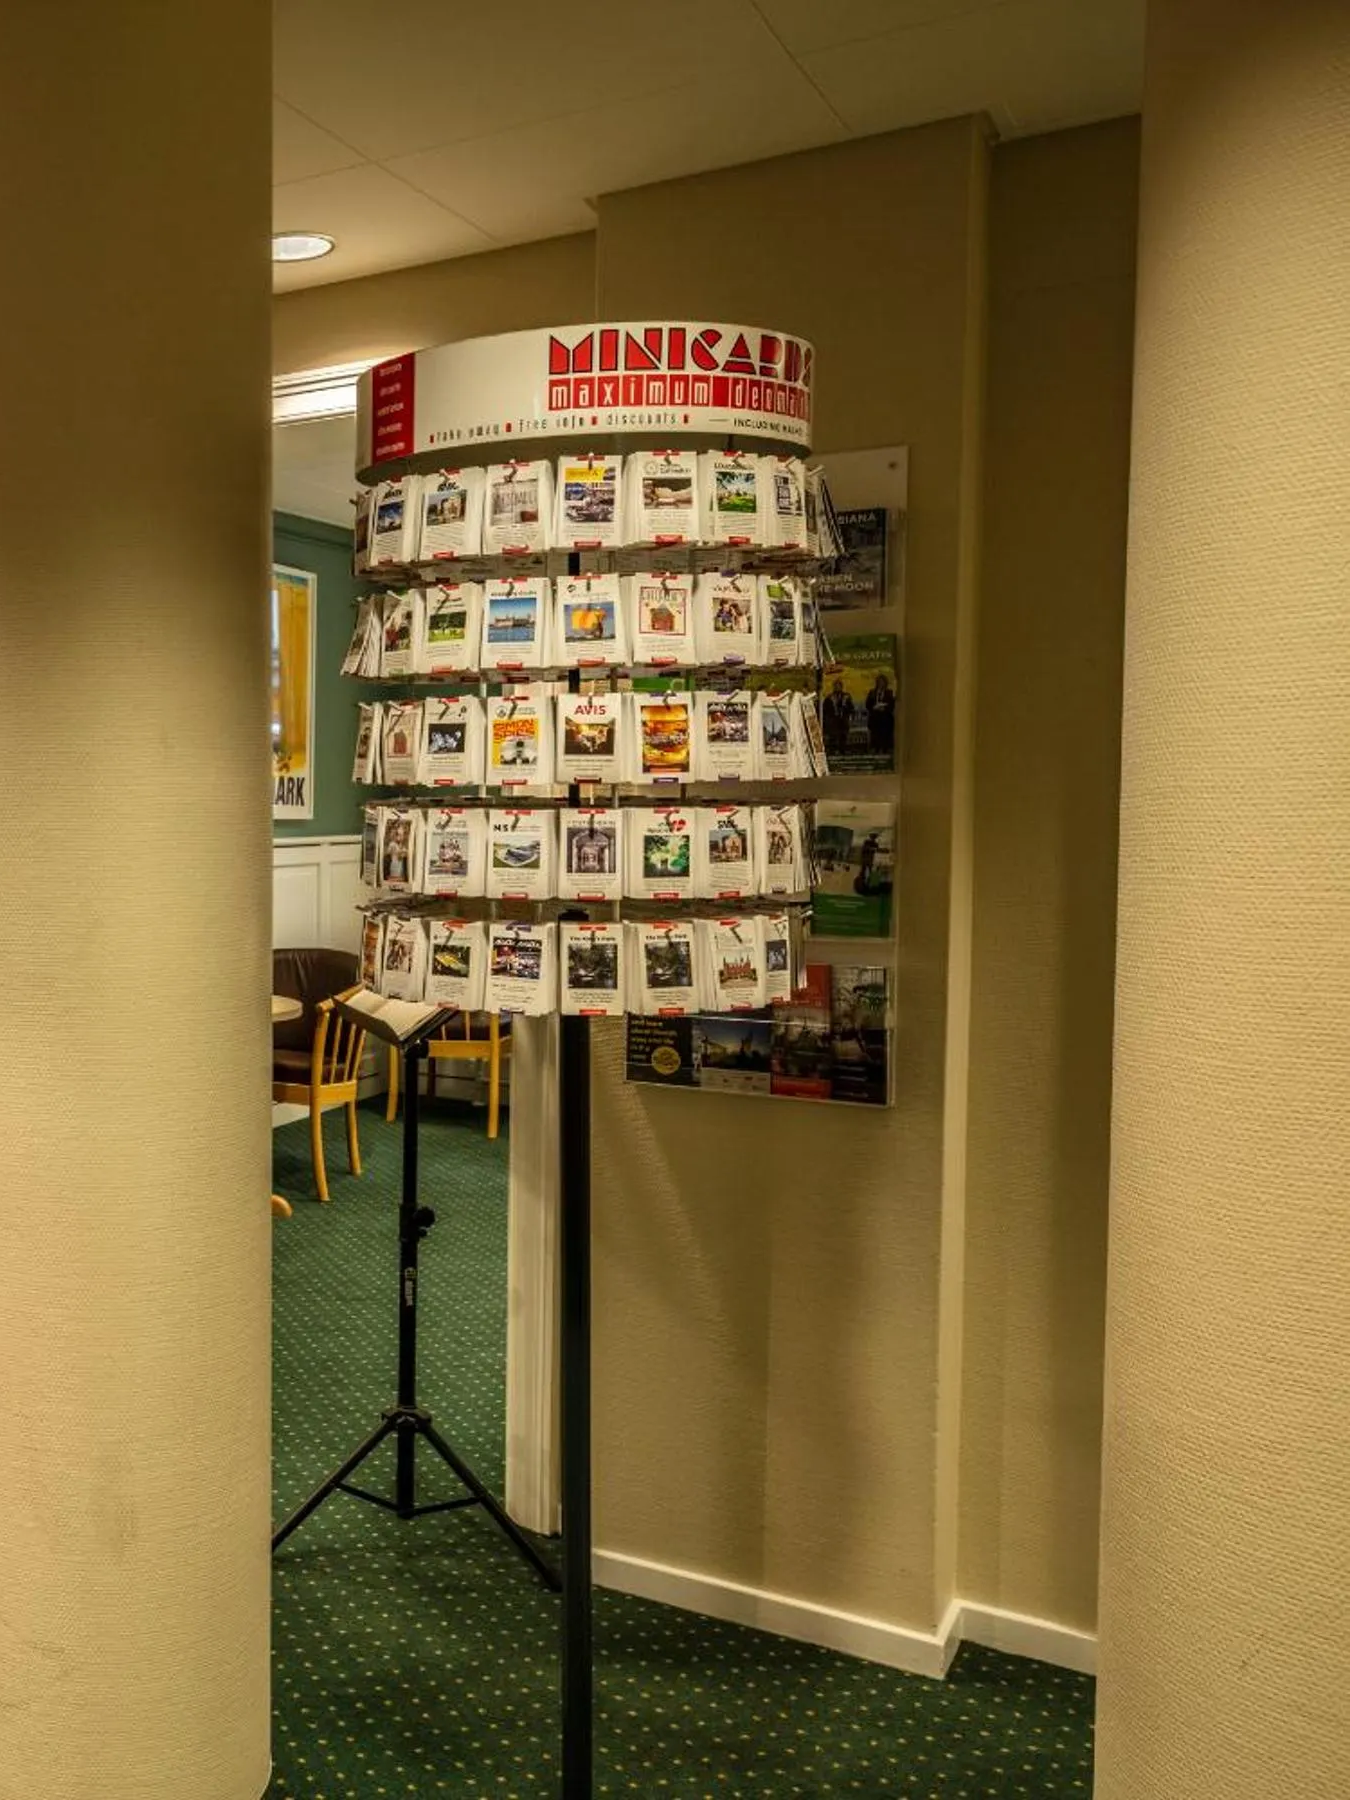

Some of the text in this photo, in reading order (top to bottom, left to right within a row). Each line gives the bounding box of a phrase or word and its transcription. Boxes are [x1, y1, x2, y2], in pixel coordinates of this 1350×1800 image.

[549, 327, 812, 387] MINICARDS
[552, 376, 710, 409] maximum
[519, 418, 547, 433] free
[574, 704, 606, 716] AVIS
[274, 776, 305, 806] ARK
